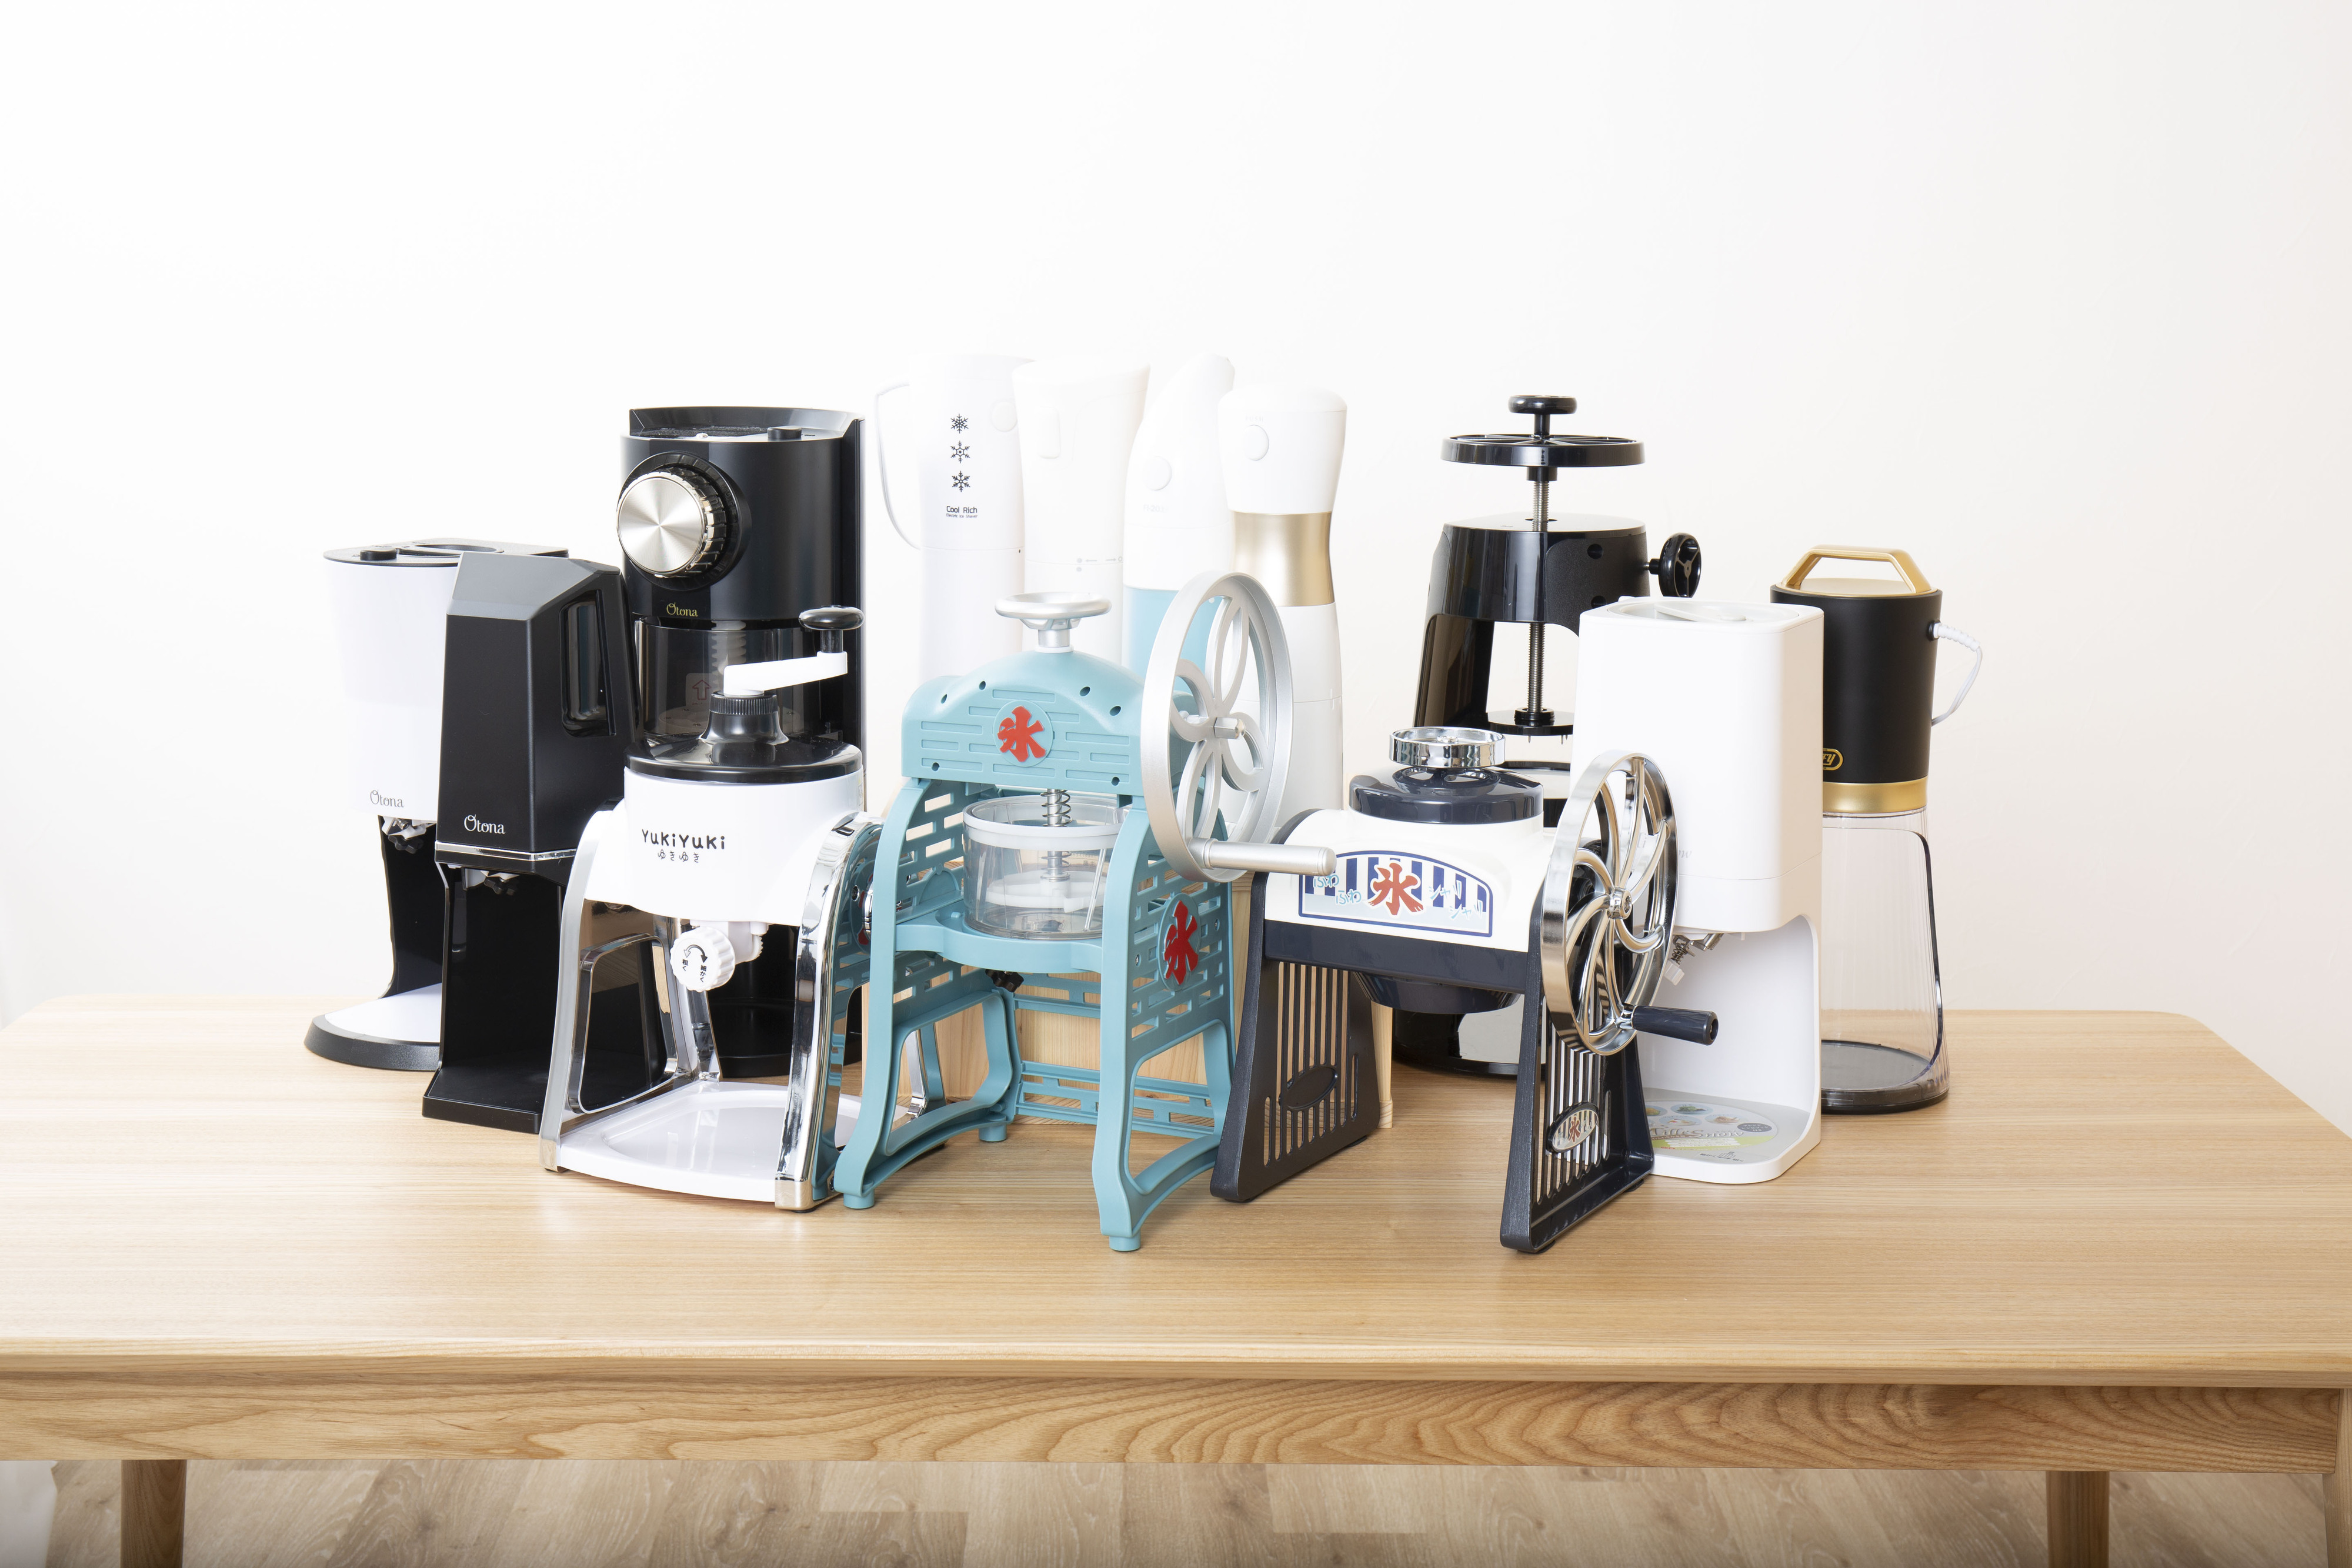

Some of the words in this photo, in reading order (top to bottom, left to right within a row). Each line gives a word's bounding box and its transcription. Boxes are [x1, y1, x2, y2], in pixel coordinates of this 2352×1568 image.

[946, 505, 960, 513] Cool
[666, 602, 698, 618] Otona
[997, 705, 1047, 763] 氷
[370, 789, 405, 808] Otona
[463, 814, 506, 835] Otona
[657, 849, 700, 863] ゆきゆき
[1336, 889, 1362, 905] ふわ
[1367, 862, 1424, 916] 氷
[1163, 900, 1199, 985] 氷
[1568, 1116, 1581, 1143] 氷
